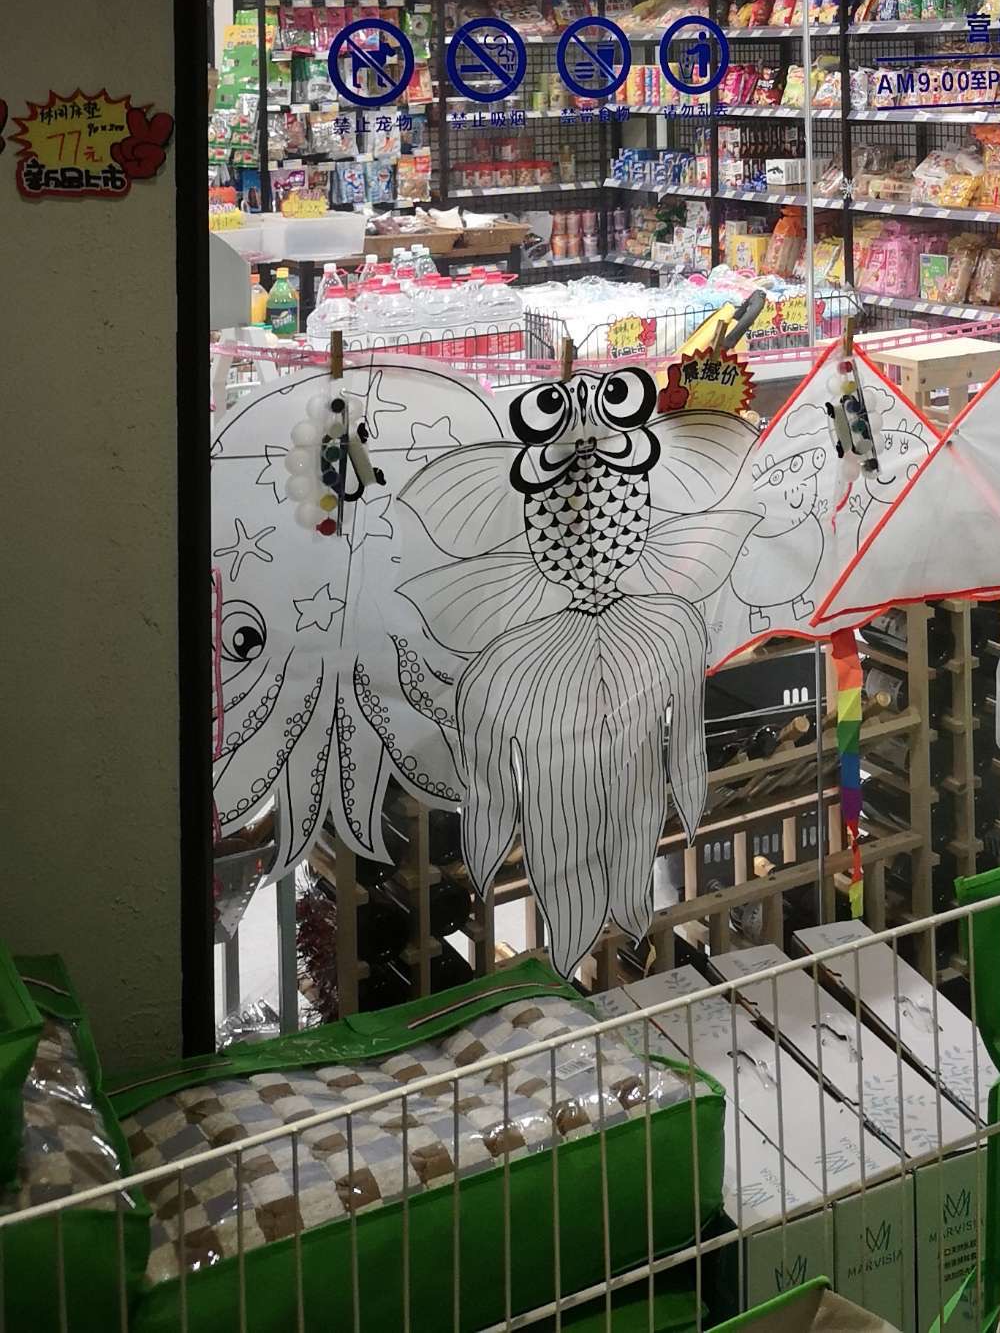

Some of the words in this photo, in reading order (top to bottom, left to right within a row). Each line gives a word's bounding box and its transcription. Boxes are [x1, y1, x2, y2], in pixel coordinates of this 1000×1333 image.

[449, 109, 528, 130] 禁止吸烟
[560, 105, 630, 125] 禁带食物
[663, 102, 729, 121] 请勿乱丢
[332, 115, 413, 135] 禁止宠物
[24, 158, 127, 190] 新品上市
